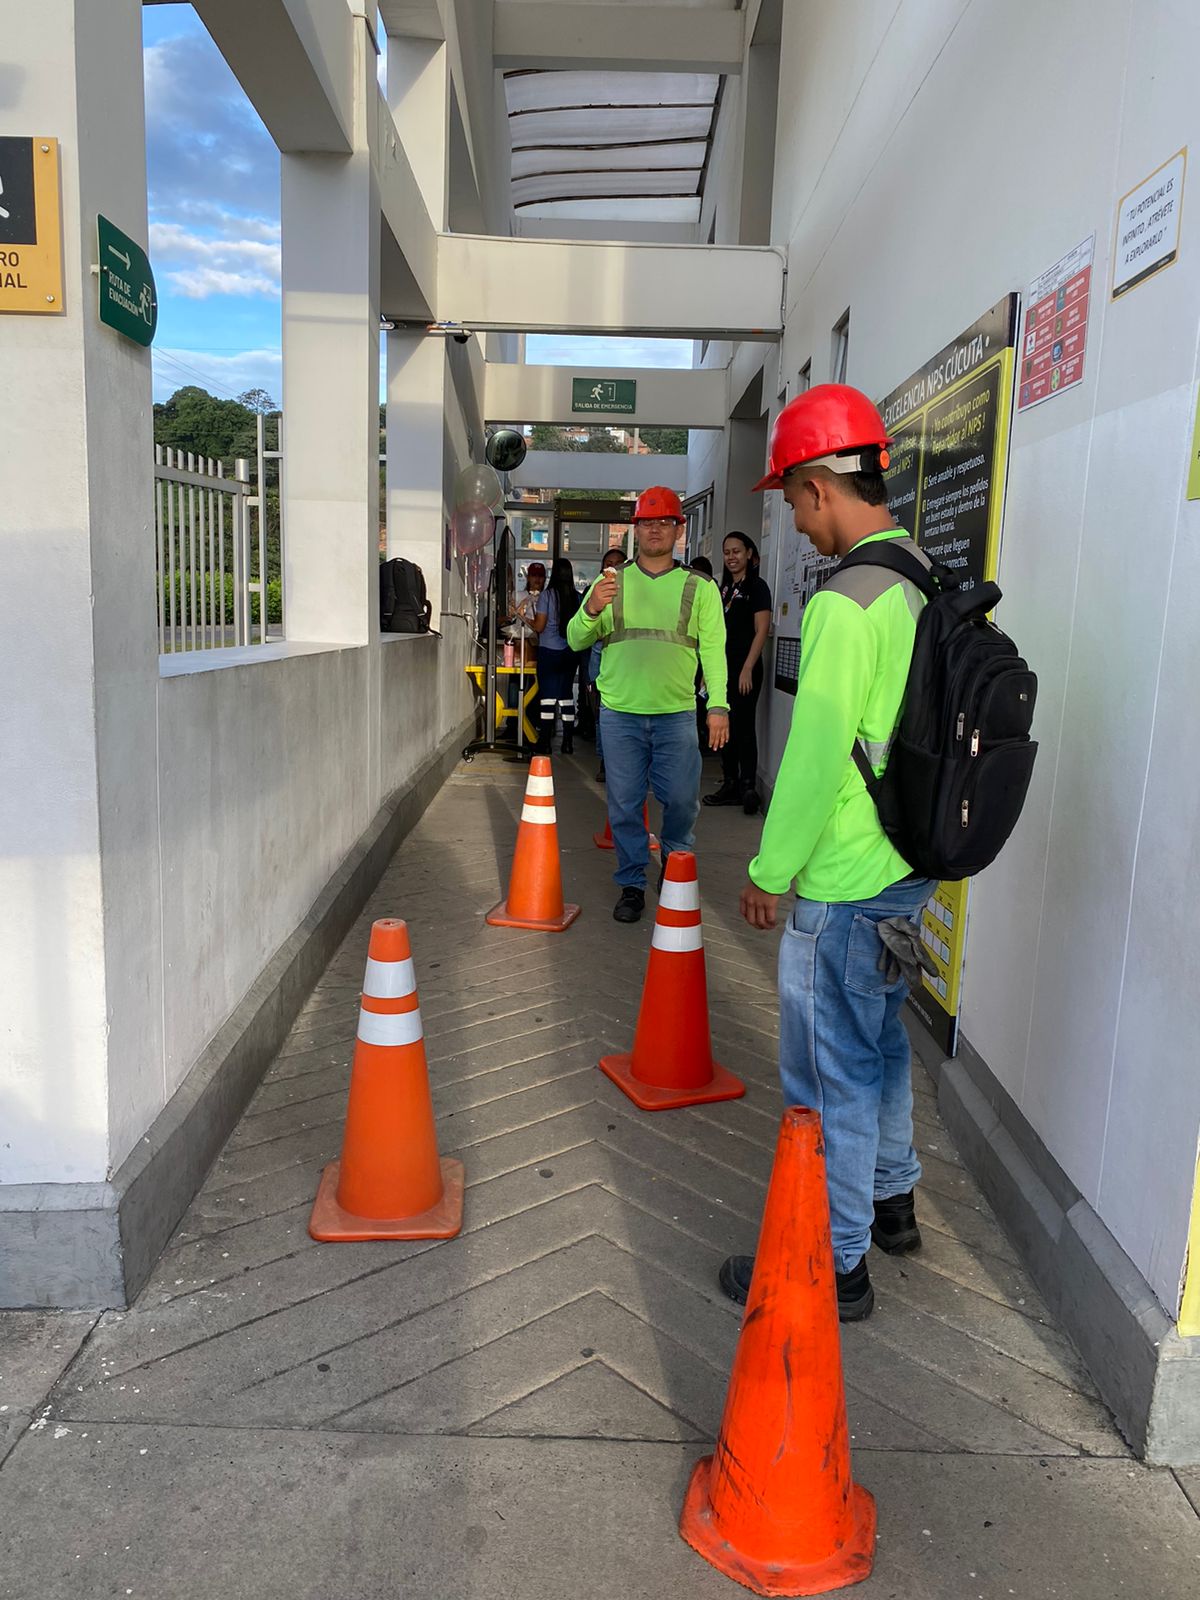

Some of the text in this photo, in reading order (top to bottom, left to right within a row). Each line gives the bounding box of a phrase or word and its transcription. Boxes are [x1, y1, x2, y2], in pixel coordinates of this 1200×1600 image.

[109, 270, 131, 297] RUTA DE
[885, 380, 925, 428] EXCELENCIA
[926, 364, 944, 398] NPS
[944, 334, 983, 384] CÚCUTA
[972, 389, 990, 410] como
[961, 421, 967, 439] al
[928, 474, 937, 488] Seré
[937, 465, 953, 483] amable
[956, 454, 985, 475] respetuoso.
[926, 493, 945, 511] Entregaré
[945, 488, 961, 503] siempre
[969, 478, 989, 497] pedidos
[925, 514, 931, 524] en
[931, 510, 940, 523] buen
[940, 504, 954, 519] estado
[958, 498, 973, 514] dentro
[973, 496, 980, 508] de
[980, 494, 985, 506] la
[924, 525, 939, 537] ventana
[943, 544, 952, 555] que
[952, 537, 970, 555] lleguen
[962, 581, 969, 591] en
[969, 576, 975, 589] la
